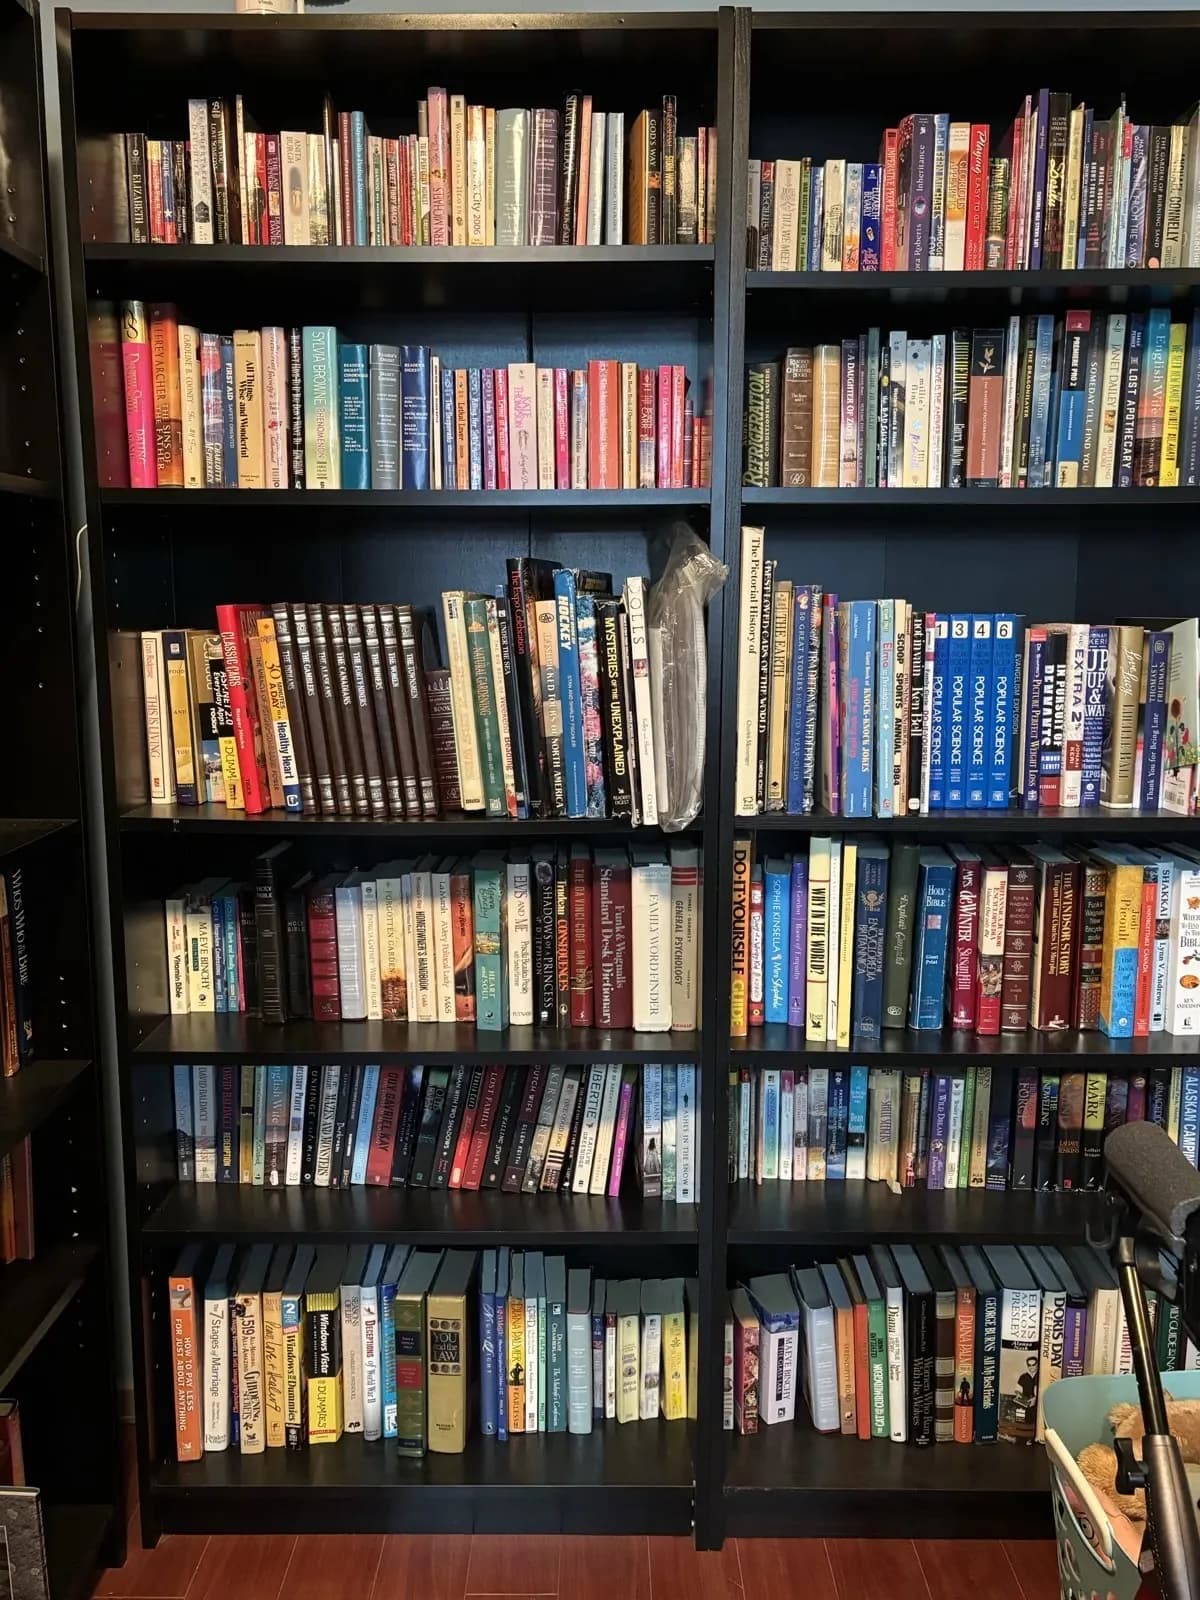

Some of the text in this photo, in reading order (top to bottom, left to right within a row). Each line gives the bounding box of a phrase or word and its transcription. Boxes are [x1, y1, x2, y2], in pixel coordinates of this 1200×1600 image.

[649, 119, 657, 145] GOD'S
[649, 148, 657, 167] WAY
[132, 174, 144, 224] ELIZABETH
[916, 144, 924, 192] Inheritance
[971, 130, 986, 230] Playing EASY TO GET
[471, 192, 482, 235] City 2006
[245, 359, 256, 402] All Things
[311, 331, 327, 459] SYLVIA BROWNE PHENOMENON
[522, 396, 532, 419] KATE
[1106, 343, 1122, 408] JANET DAILEY
[1150, 334, 1166, 416] English Wife
[238, 380, 250, 459] Wise and Wonderful
[742, 369, 765, 488] REFRIGERATION
[1121, 367, 1139, 470] LOST APOTHECARY
[509, 569, 527, 655] The Expo Celebration
[557, 595, 572, 651] HOCKEY
[746, 537, 761, 655] The Pictorial History of
[220, 631, 242, 687] CLASSIC CARS
[773, 612, 788, 679] THE EARTH
[954, 622, 965, 637] 3
[976, 623, 987, 636] 4
[998, 623, 1009, 638] 6
[264, 660, 281, 680] 30
[335, 652, 352, 705] THE CANADIANS
[472, 646, 493, 716] NATURAL GARDENING
[603, 617, 626, 776] MYSTERIES OF THE UNEXPLAINED
[860, 687, 873, 773] KNOCK-KNOCK JOKES
[892, 633, 906, 786] SCOOP SPORTS ANNUAL 1984
[909, 686, 924, 737] Ken Bell
[950, 675, 964, 765] POPULAR SCIENCE
[972, 675, 985, 765] POPULAR SCIENCE
[993, 676, 1007, 766] POPULAR SCIENCE
[1028, 679, 1042, 788] PICTURE PERFECT WEIGHT LOSS
[276, 721, 295, 780] Healthy Heart
[550, 737, 566, 809] NORTH AMERICA
[771, 879, 782, 953] SOPHIE KINSELLA
[1058, 871, 1073, 976] THE WINDSOR STORY
[1158, 869, 1170, 917] SHAKKAI
[198, 921, 210, 990] MAEVE BINCHY
[415, 911, 429, 992] HOMEOWNER'S HANDBOOK
[599, 868, 614, 1025] Standard Desk Dictionary
[673, 900, 684, 986] GENERAL PSYCHOLOGY
[809, 887, 826, 976] WHY IN THE WORLD?
[17, 954, 29, 986] BIBLE
[732, 979, 746, 1027] GUIDE
[377, 1071, 399, 1152] GUY GAVRIEL KAY
[682, 1109, 690, 1133] ASHES
[1086, 1079, 1099, 1120] MARK
[1180, 1075, 1199, 1166] ALASKAN CAMPIN
[317, 1093, 337, 1177] MAZES AND MONSTERS
[682, 1134, 689, 1144] IN
[319, 1313, 330, 1375] Windows Vista
[364, 1319, 377, 1358] DECEPTIONS
[510, 1302, 525, 1363] DIANA PALMER
[887, 1305, 900, 1334] Diana
[958, 1314, 974, 1377] DIANA PALMER
[1009, 1290, 1021, 1338] PRESLEY
[1020, 1291, 1028, 1339] AARON
[1027, 1293, 1038, 1340] ELVIS
[1050, 1296, 1066, 1369] DORIS DAY
[174, 1318, 187, 1431] FOR JUST ABOUT ANYTHING
[184, 1337, 194, 1412] HOW TO PAY LESS
[209, 1310, 225, 1398] 7 Stages of Marriage
[285, 1335, 298, 1423] Windows Dummies
[366, 1360, 377, 1368] of
[366, 1368, 377, 1386] World
[782, 1336, 793, 1400] MAEVE BINCHY
[980, 1296, 997, 1410] GEORGE BURNS All My Best Friends
[316, 1385, 328, 1428] DUMMIES
[366, 1385, 377, 1399] War
[912, 1357, 924, 1427] With the Wolves
